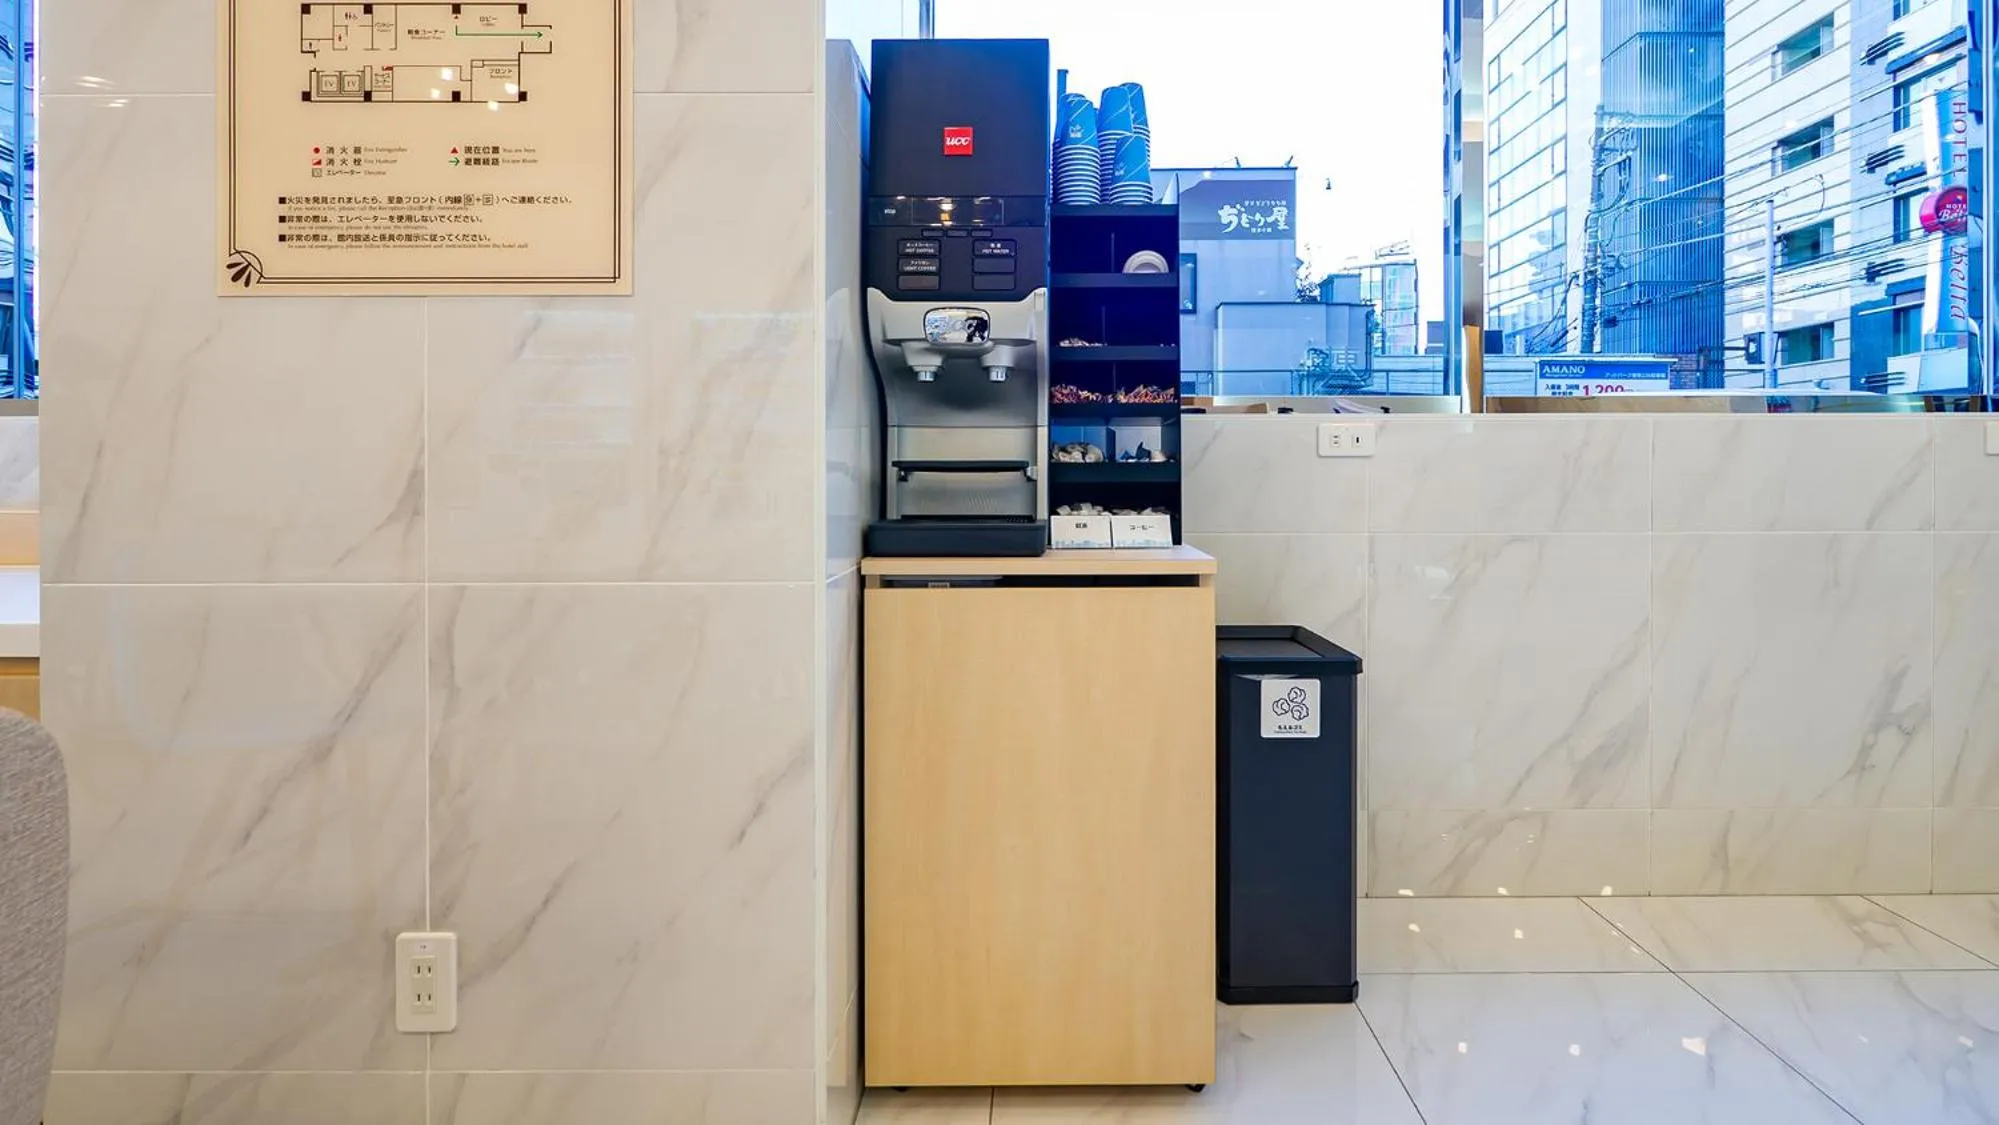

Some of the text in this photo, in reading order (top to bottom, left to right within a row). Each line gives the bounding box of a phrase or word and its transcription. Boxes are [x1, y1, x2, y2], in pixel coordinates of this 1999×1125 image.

[464, 146, 500, 154] 現在位置
[1543, 365, 1585, 373] AMANO
[1583, 385, 1624, 396] 1200
